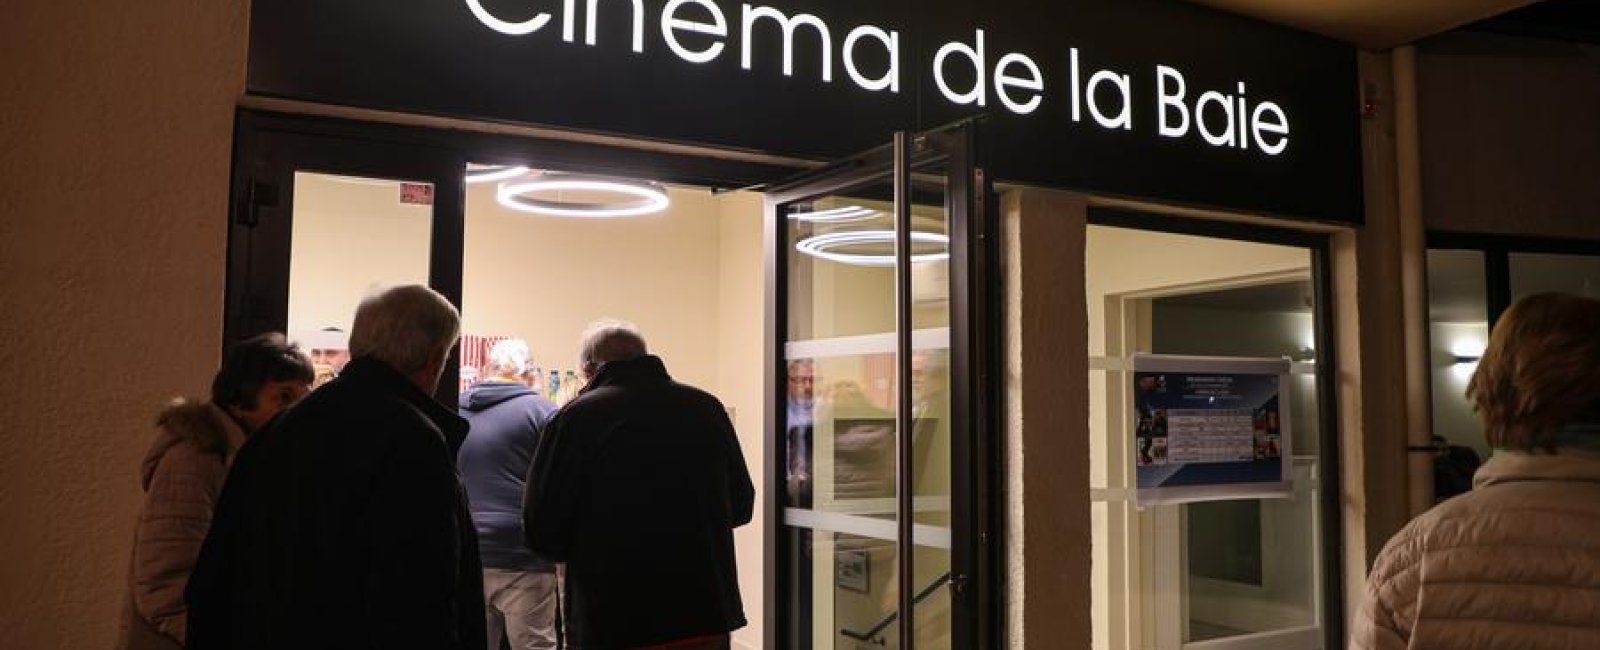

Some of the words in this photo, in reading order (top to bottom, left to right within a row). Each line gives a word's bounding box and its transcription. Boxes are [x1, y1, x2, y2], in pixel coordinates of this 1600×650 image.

[932, 29, 1044, 115] de
[1069, 47, 1132, 131] la
[1156, 65, 1290, 156] Baie
